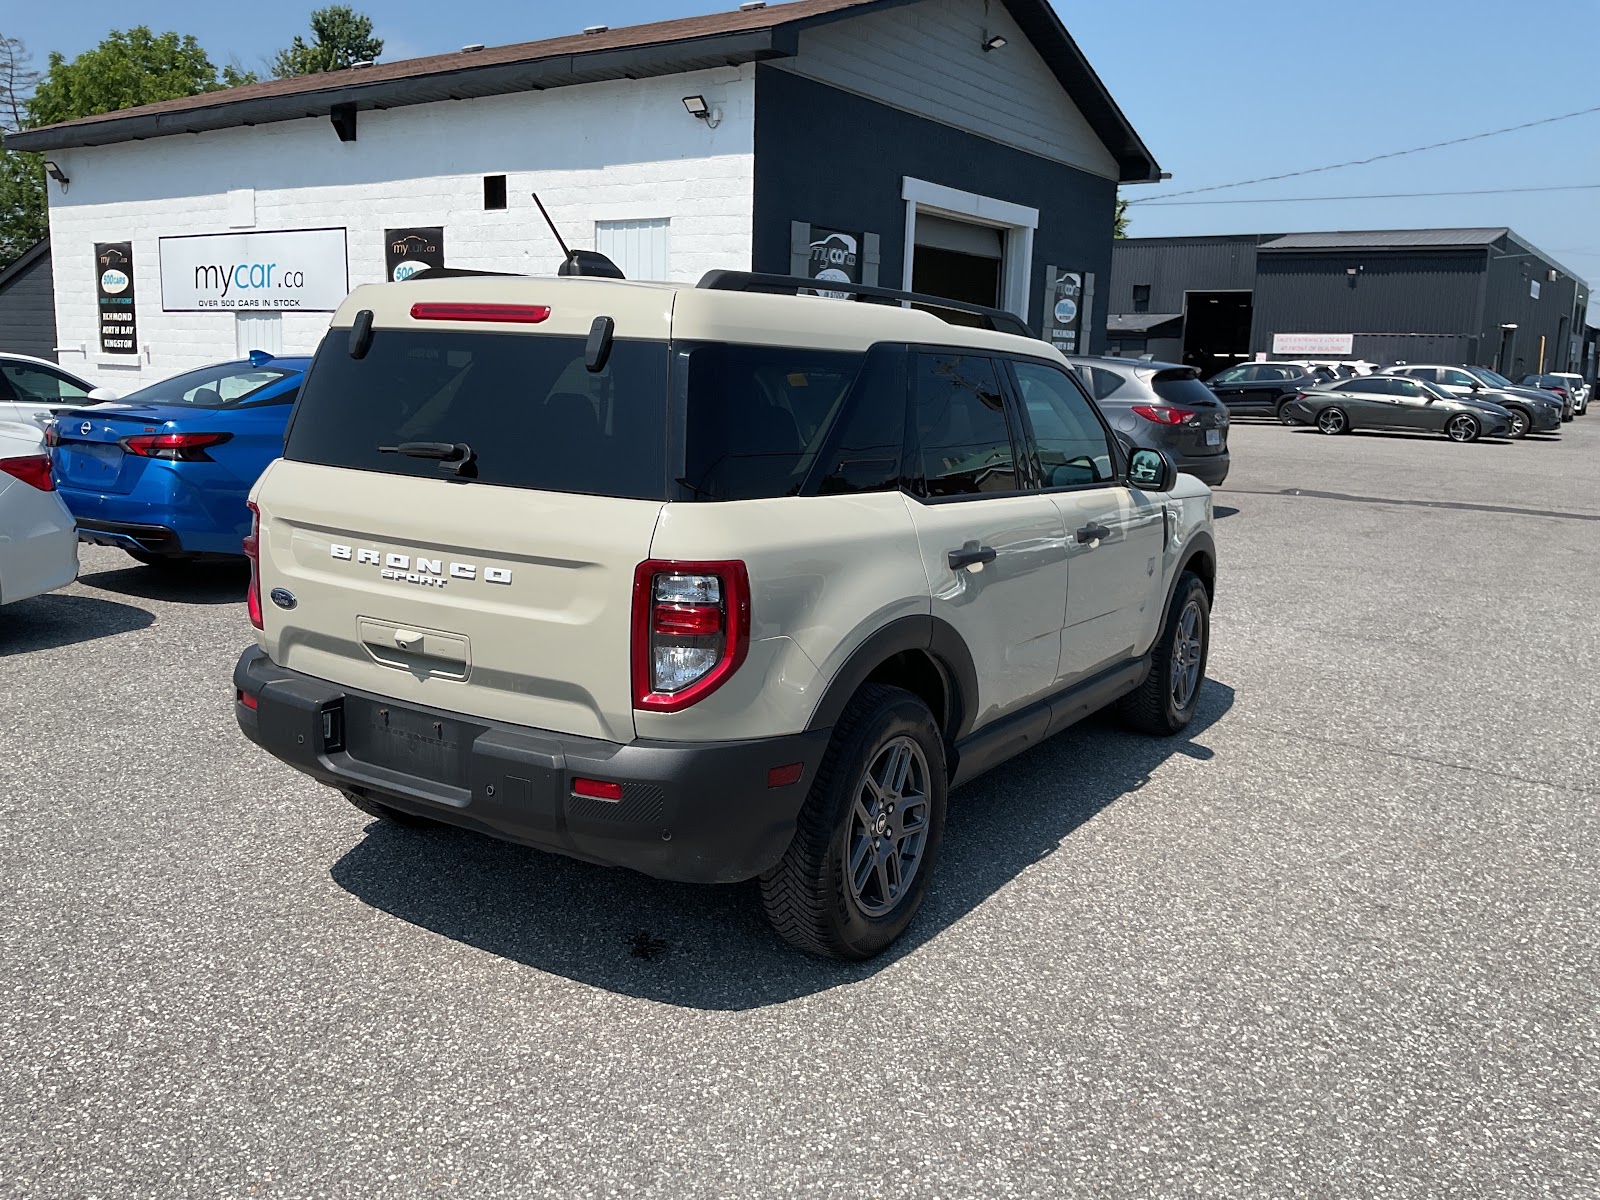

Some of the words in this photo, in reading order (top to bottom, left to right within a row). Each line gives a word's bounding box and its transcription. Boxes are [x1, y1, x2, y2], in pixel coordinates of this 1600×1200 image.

[393, 244, 436, 256] myar.ca
[100, 256, 128, 266] my.ca
[195, 263, 304, 298] mycar.ca
[273, 299, 301, 307] STOCK
[120, 326, 134, 335] BAY
[104, 339, 133, 348] KINGSTON
[330, 543, 512, 585] BRONCO
[380, 568, 448, 588] SPORT
